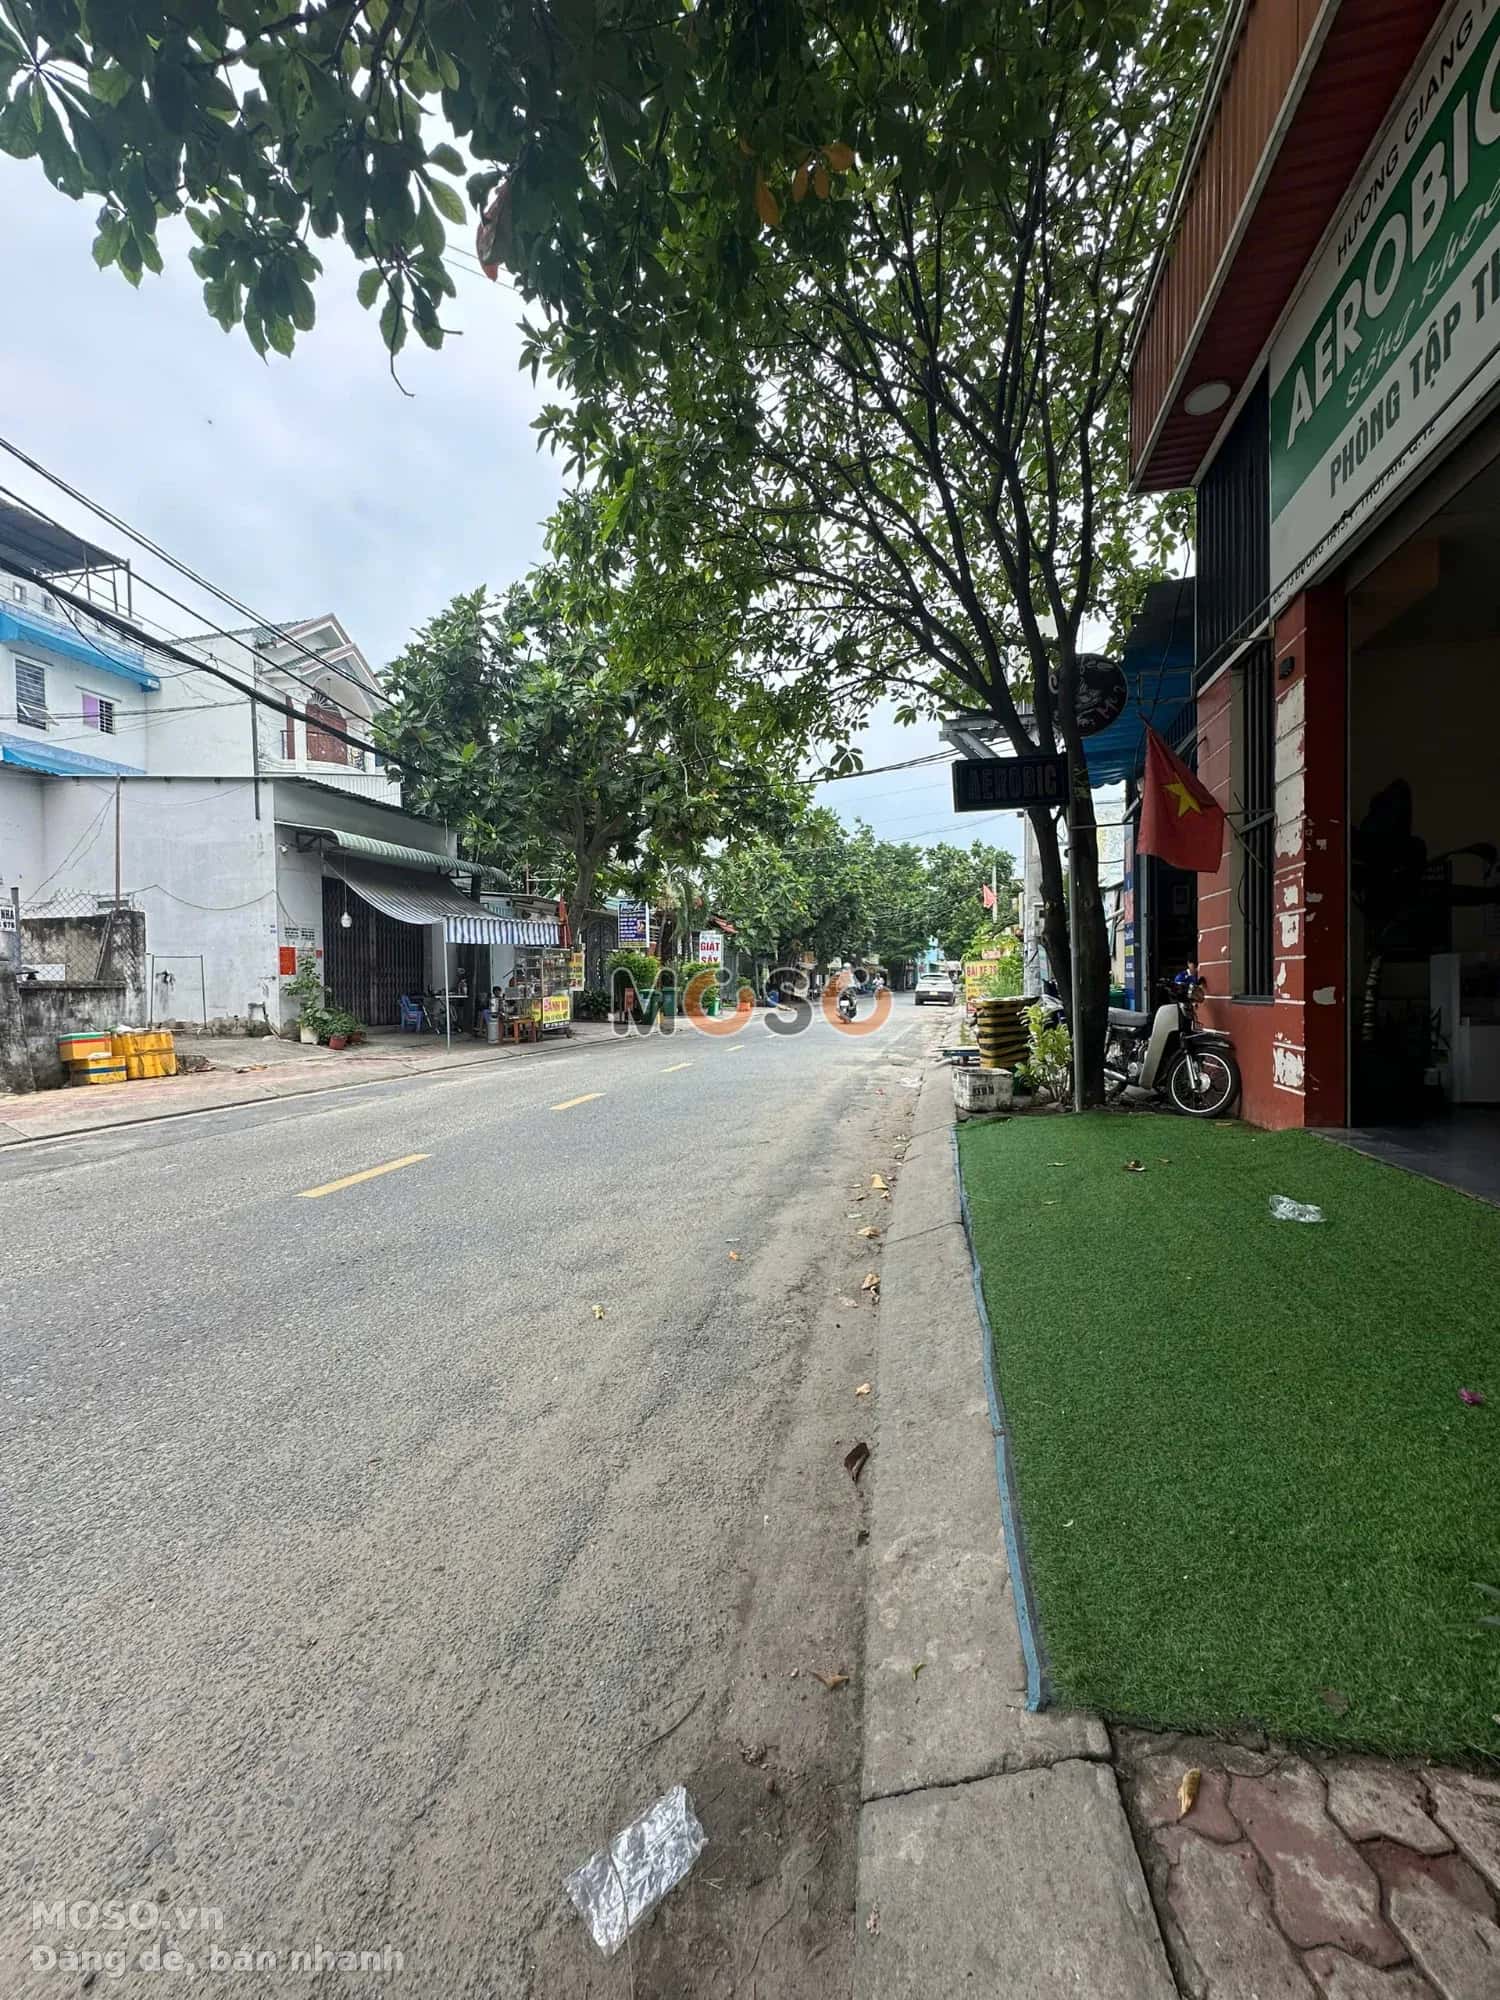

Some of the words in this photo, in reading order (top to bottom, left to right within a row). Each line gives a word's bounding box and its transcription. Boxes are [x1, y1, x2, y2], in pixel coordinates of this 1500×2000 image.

[1404, 8, 1473, 143] GIANG
[1329, 379, 1401, 498] PHÒNG
[1409, 301, 1461, 400] TẬP
